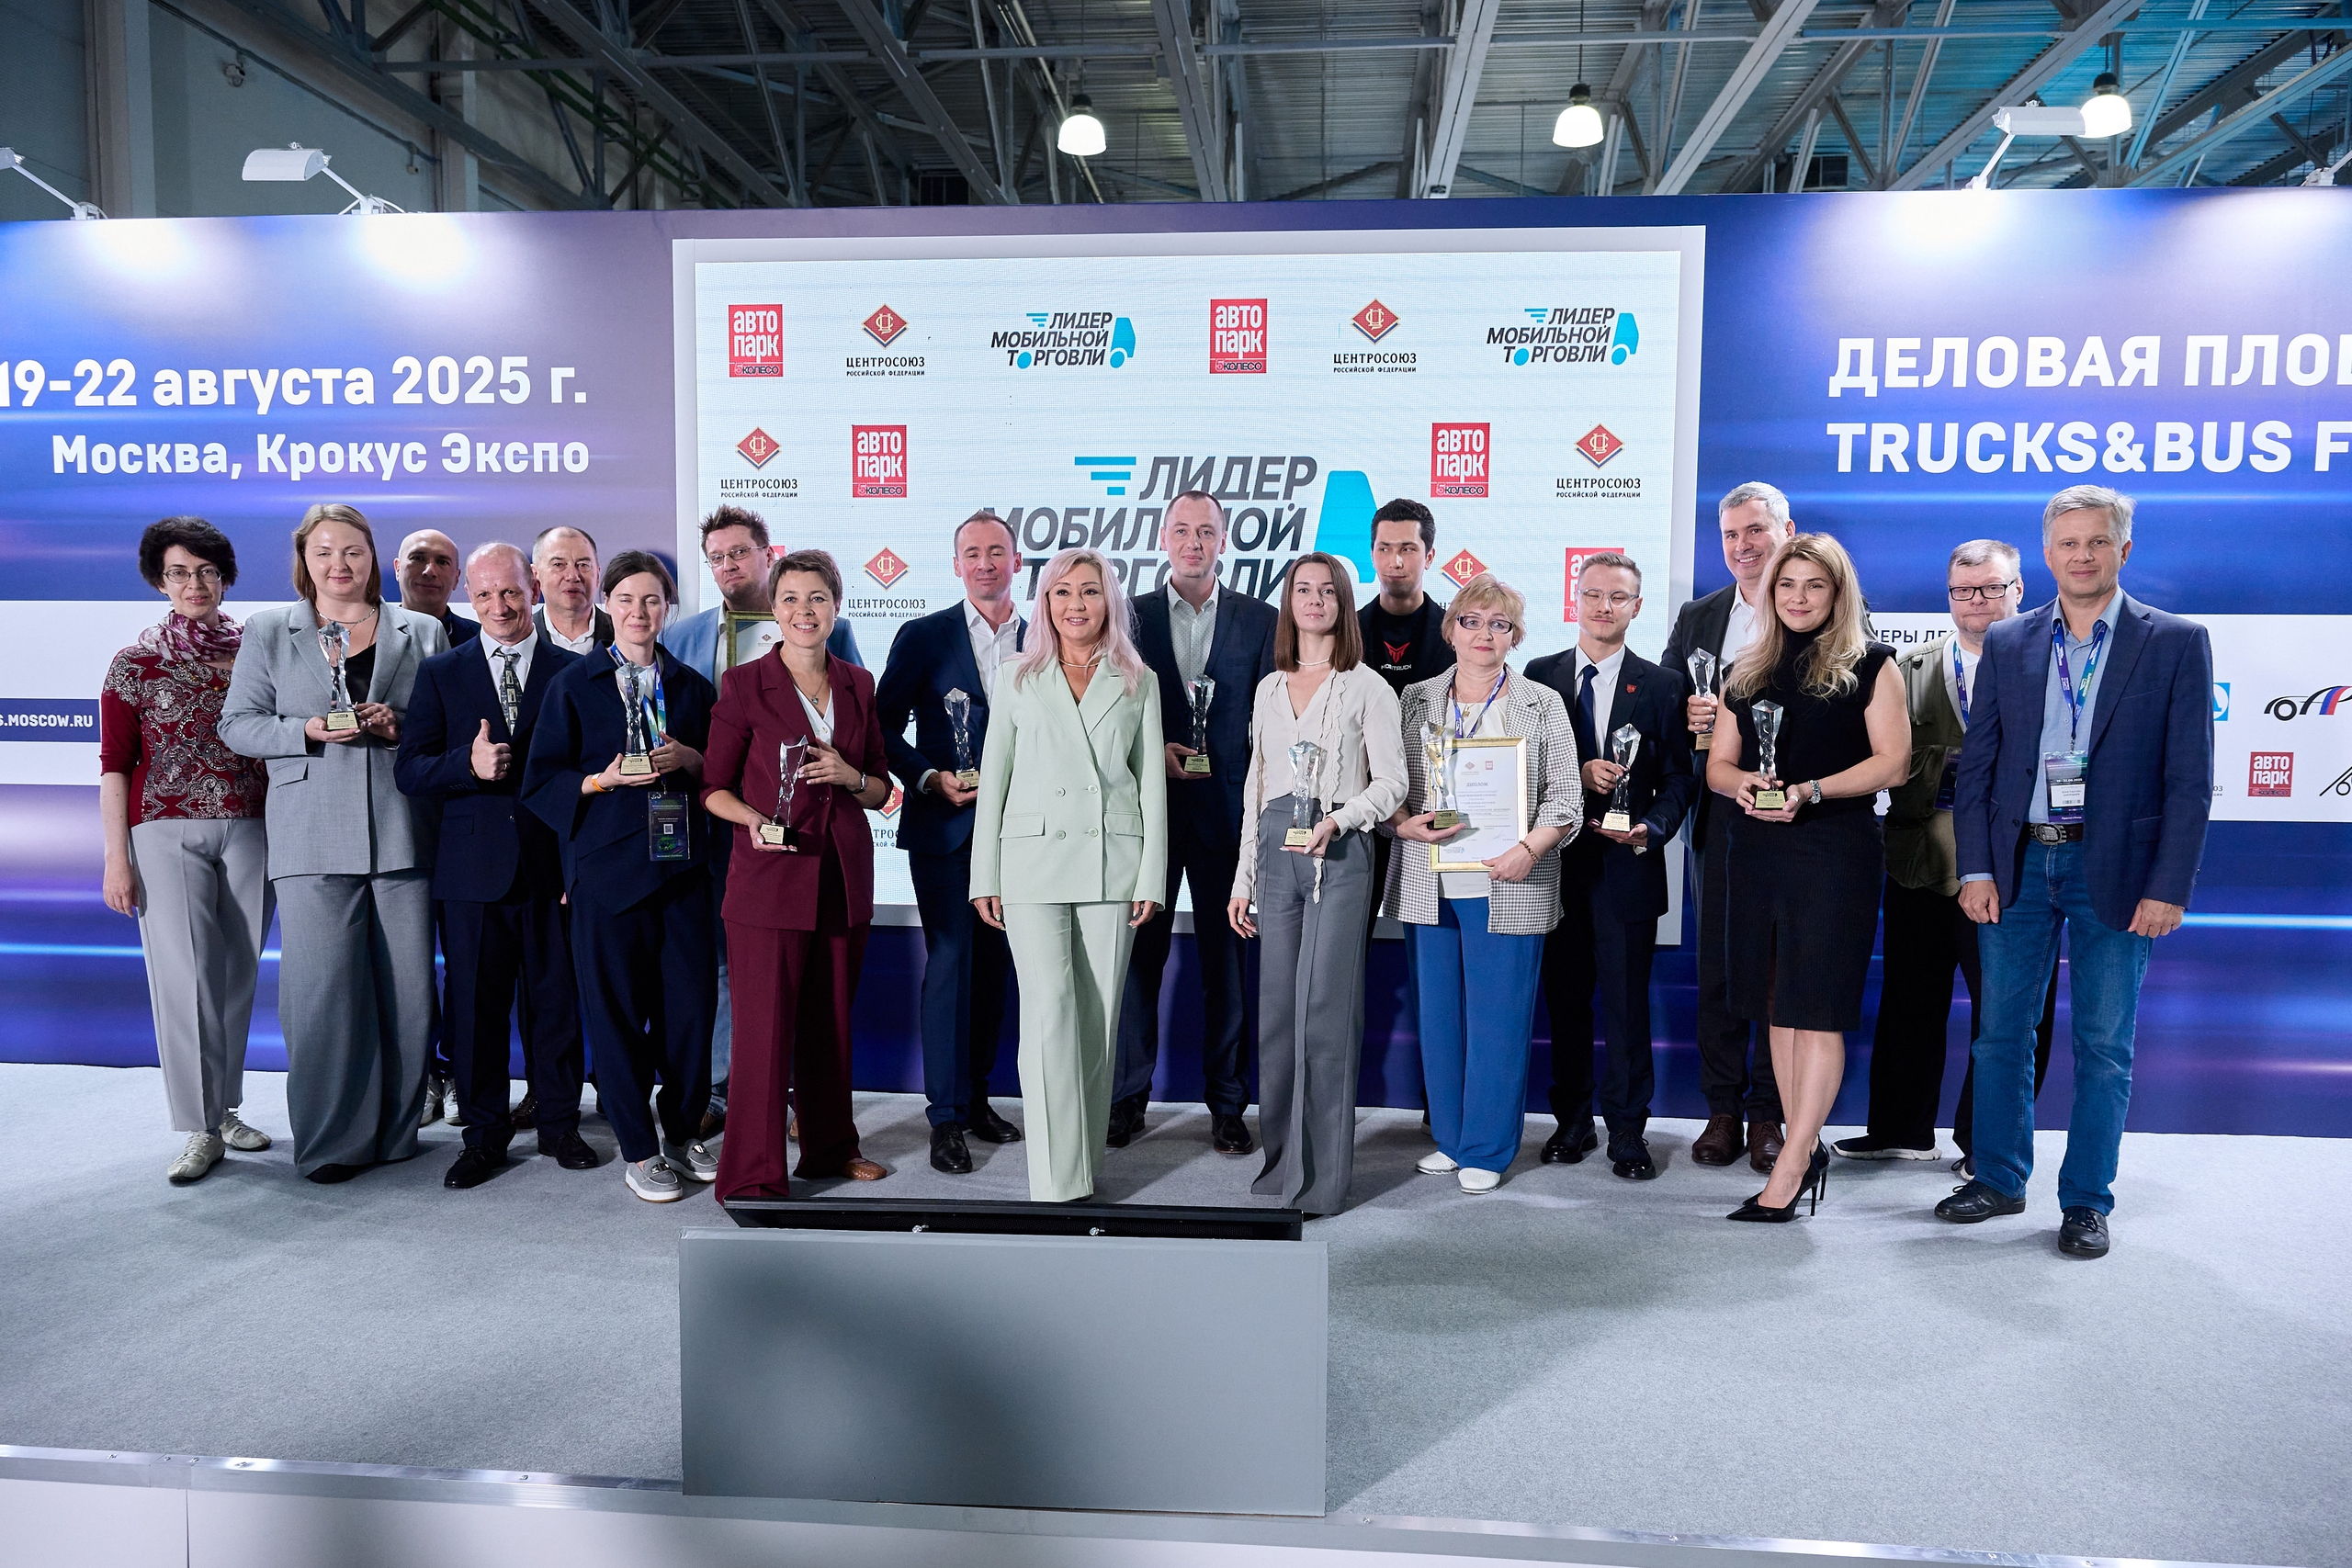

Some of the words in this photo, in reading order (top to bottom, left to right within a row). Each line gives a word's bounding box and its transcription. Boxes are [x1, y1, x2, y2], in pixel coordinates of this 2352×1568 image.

[1049, 312, 1113, 329] ЛИДЕР
[1548, 308, 1615, 324] ЛИДЕР
[990, 329, 1109, 348] МОБИЛЬНОЙ
[1487, 325, 1611, 344] МОБИЛЬНОЙ
[846, 356, 925, 367] ЦЕНТРОСОЮЗ
[1333, 353, 1417, 365] ЦЕНТРОСОЮЗ
[1828, 335, 2161, 398] ДЕЛОВАЯ
[0, 358, 137, 407] 19-22
[153, 367, 375, 415] августа
[391, 355, 531, 405] 2025
[550, 367, 587, 403] г.
[52, 434, 243, 479] Москва,
[257, 434, 427, 480] Крокус
[441, 433, 589, 473] Экспо
[1826, 420, 2292, 474] TRUCKS&BUS
[720, 479, 798, 490] ЦЕНТРОСОЮЗ
[1138, 456, 1317, 501] ЛИДЕР
[1556, 478, 1641, 490] ЦЕНТРОСОЮЗ
[981, 502, 1307, 551] ОБИЛОЙ
[848, 599, 926, 609] ЦЕНТРОСОЮЗ
